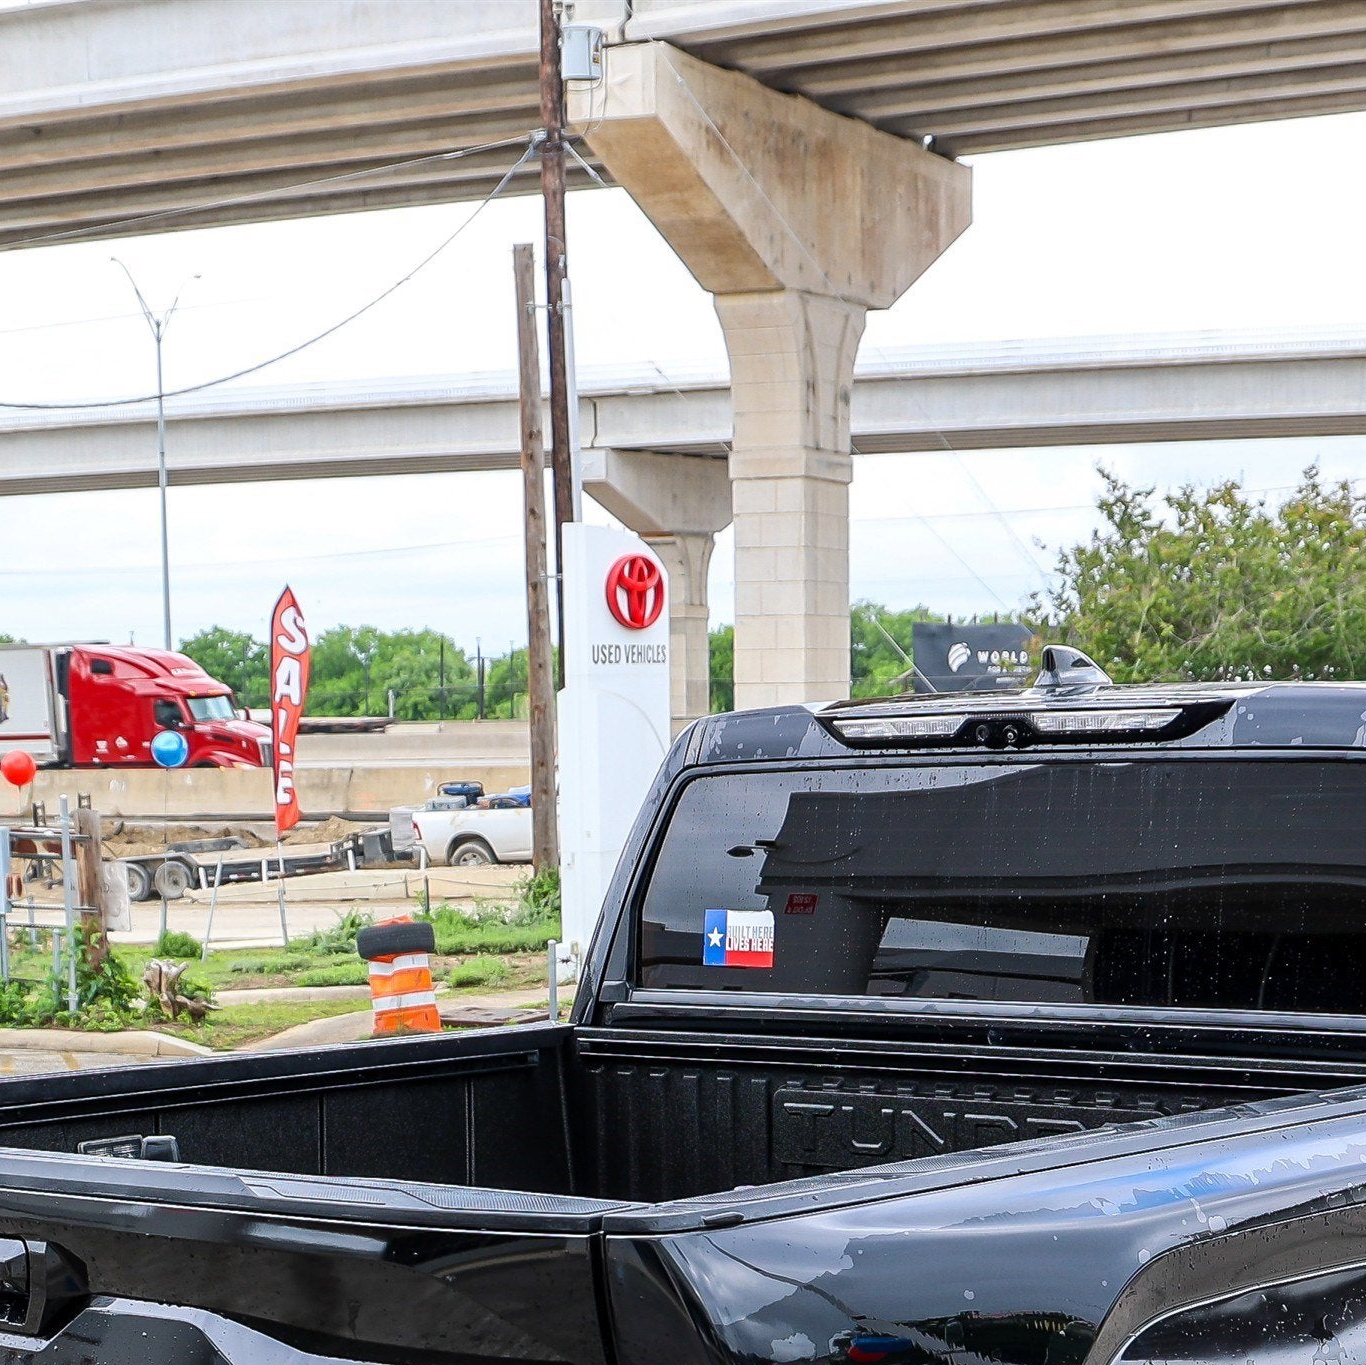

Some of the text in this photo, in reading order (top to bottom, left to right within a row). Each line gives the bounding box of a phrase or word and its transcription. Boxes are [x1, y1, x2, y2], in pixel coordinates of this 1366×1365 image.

[591, 643, 667, 665] USED VEHICLES
[976, 650, 1029, 664] WORLD
[276, 605, 310, 805] SALE
[726, 925, 774, 940] BUILT HERE
[725, 938, 775, 953] LIVES HERE
